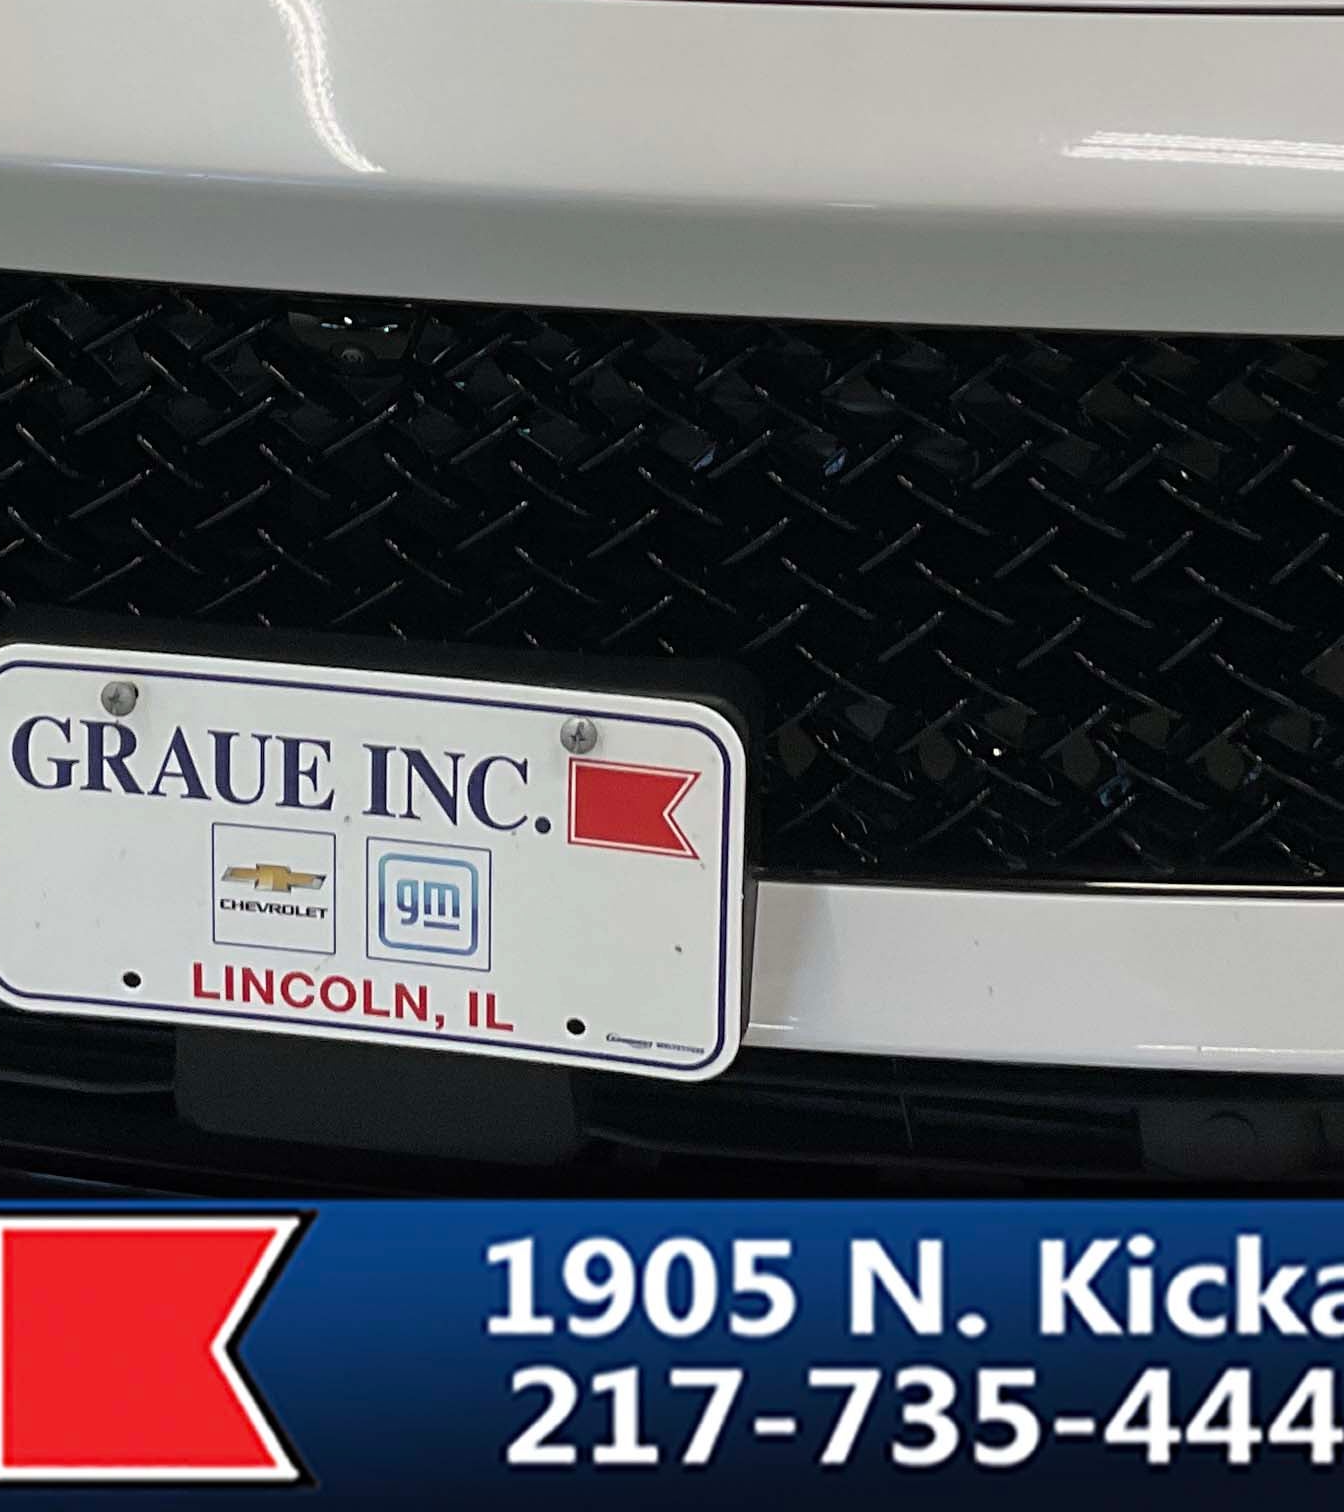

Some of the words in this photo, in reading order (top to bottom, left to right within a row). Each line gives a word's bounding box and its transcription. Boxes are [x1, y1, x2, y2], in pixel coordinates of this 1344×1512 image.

[11, 715, 335, 813] GRAUE
[362, 744, 552, 834] INC.
[219, 898, 328, 919] CHEVROLET
[396, 879, 460, 932] gm
[192, 962, 446, 1031] LINCOLN,
[467, 991, 514, 1032] IL
